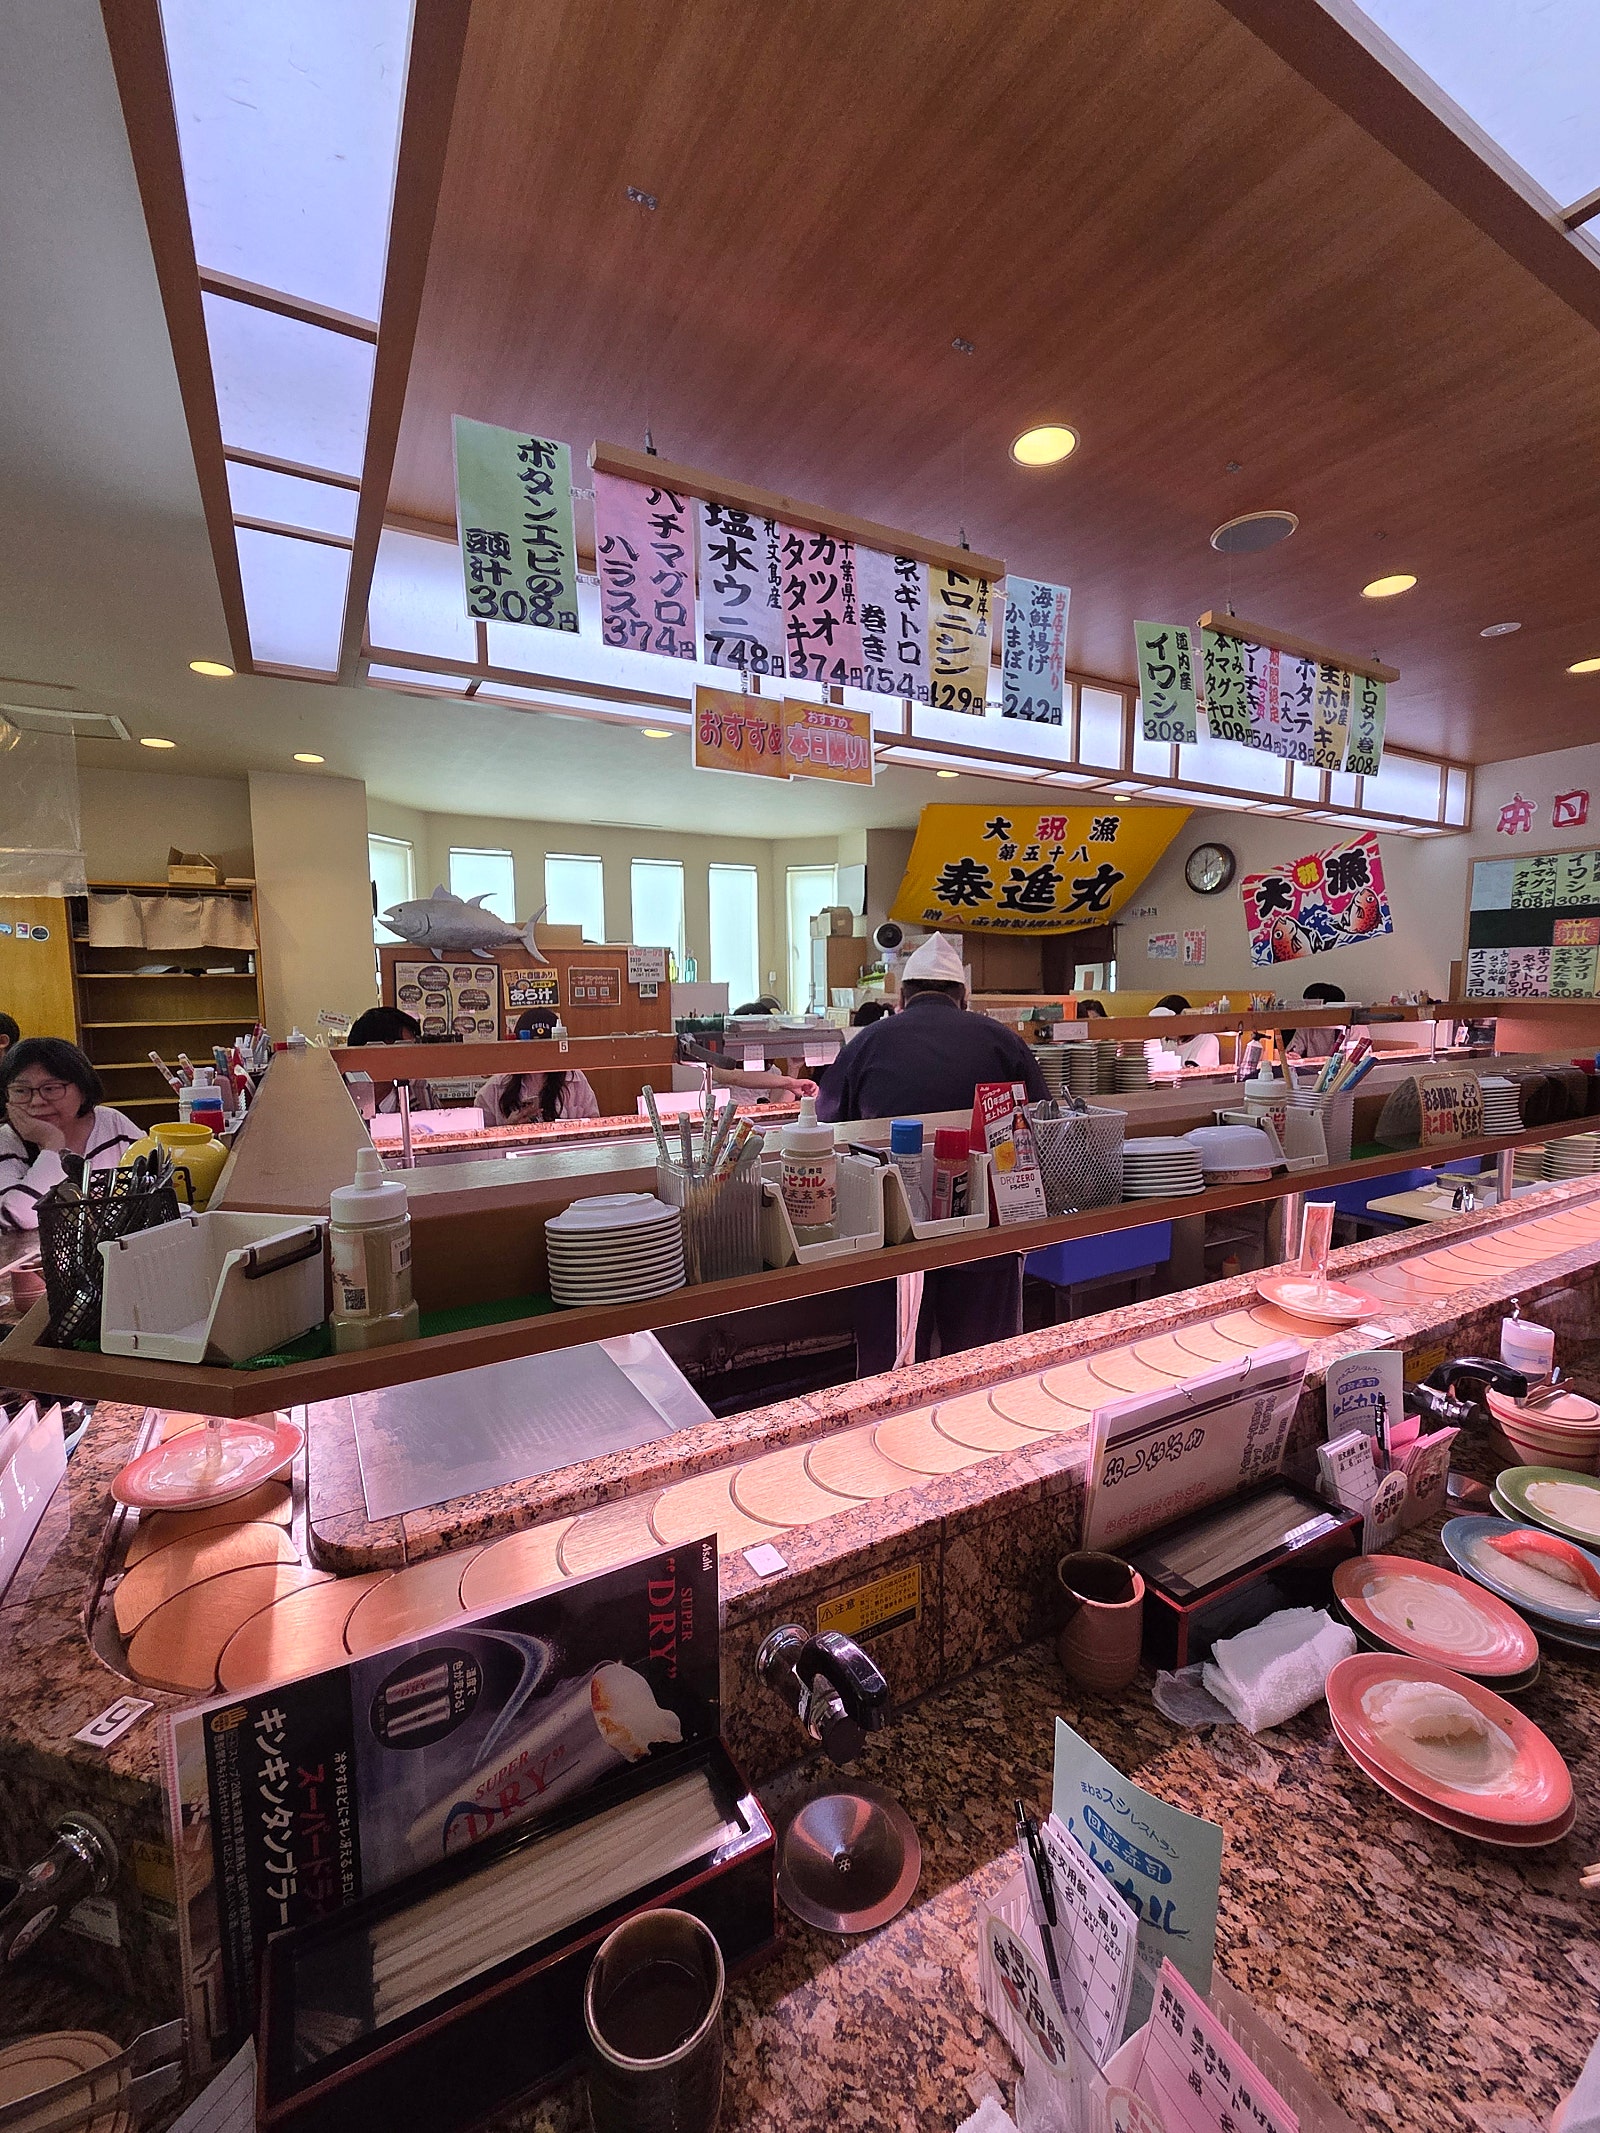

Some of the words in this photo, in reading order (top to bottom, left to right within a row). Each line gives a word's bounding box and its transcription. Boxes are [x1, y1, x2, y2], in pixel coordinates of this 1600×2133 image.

[517, 438, 564, 598] ボタンエビの
[466, 527, 512, 586] 頭汁
[598, 535, 639, 618] ハラス
[704, 504, 759, 643] 塩水ウニ
[763, 520, 783, 610] 礼文島産
[839, 540, 857, 625] 千葉県産
[470, 584, 579, 634] 308円
[782, 533, 812, 653] タタキ
[808, 533, 840, 646] カツオ
[894, 556, 921, 665] ネギトロ
[604, 615, 696, 660] 374円
[860, 603, 887, 662] 巻き
[935, 568, 974, 674] トロニシン
[1004, 603, 1025, 692] かまぼこ
[1027, 584, 1054, 675] 海鮮揚げ
[1050, 591, 1067, 692] 当店手作り
[705, 633, 785, 678] 748円
[790, 651, 862, 690] 374円
[1145, 632, 1179, 719] イワシ
[1214, 632, 1235, 719] 本マグロ
[1003, 693, 1062, 725] 242円
[1204, 648, 1219, 719] タタキ
[1294, 659, 1316, 733] ホタテ
[699, 709, 783, 754] おすすめ
[807, 711, 849, 729] おすすめ
[1144, 719, 1196, 743] 308円
[1253, 729, 1281, 754] 54円
[1315, 748, 1340, 771] 29円
[1345, 753, 1378, 776] 308円
[998, 843, 1090, 863] 第五十八
[1567, 853, 1587, 893] イワシ
[932, 857, 1125, 915] 泰進丸
[1511, 897, 1554, 909] 308円
[1514, 870, 1530, 898] タタキ
[1508, 960, 1521, 987] うずら
[1522, 954, 1536, 990] ネギトロ
[1536, 947, 1552, 982] 本マグロ
[510, 987, 553, 1001] あら汁
[1467, 988, 1505, 997] 154円
[1507, 988, 1547, 998] 374円
[1549, 988, 1594, 998] 308円
[1102, 1427, 1206, 1488] おしながき
[702, 1543, 713, 1571] Asahi
[681, 1587, 693, 1642] SUPER
[834, 1598, 856, 1615] 注意
[475, 1750, 529, 1801] SUPER
[1080, 1781, 1180, 1859] まわるスシレストラン
[1087, 1808, 1165, 1881] 回転寿司
[1047, 1840, 1088, 1901] 注文用紙
[993, 1935, 1066, 2063] 注文用紙
[1190, 2039, 1241, 2113] デザート
